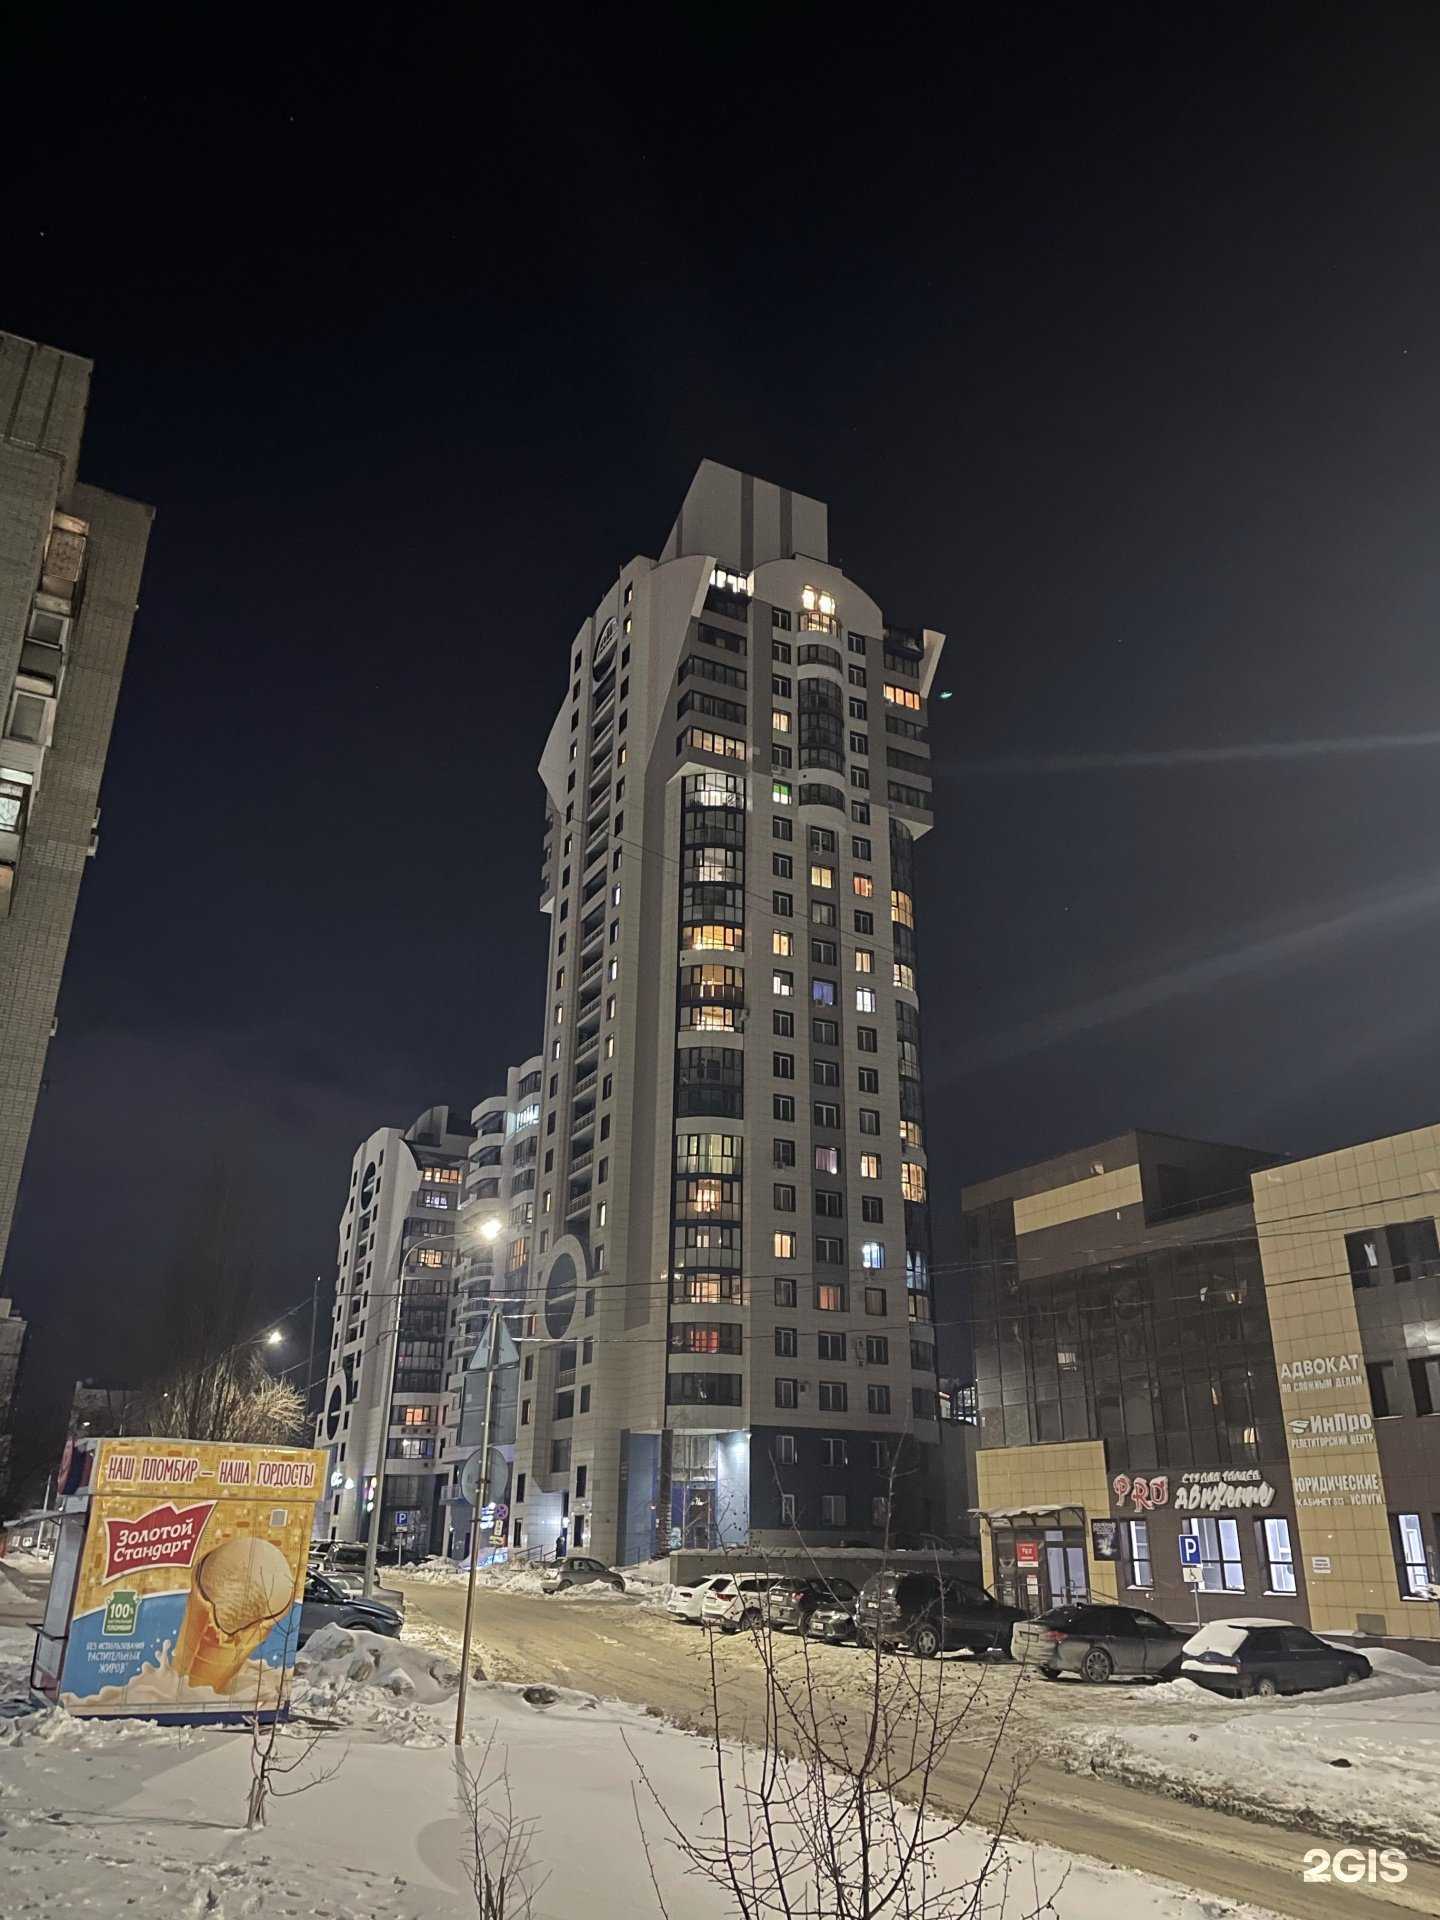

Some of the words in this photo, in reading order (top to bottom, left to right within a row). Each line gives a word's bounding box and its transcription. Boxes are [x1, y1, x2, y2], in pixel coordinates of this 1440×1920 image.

[1281, 1354, 1359, 1379] АДВОКАТ
[1281, 1383, 1292, 1393] ПО
[1336, 1375, 1363, 1388] ДЕЛАМ
[1310, 1413, 1372, 1433] ИнПро
[1351, 1433, 1374, 1445] ЦЕНТР
[107, 1457, 135, 1480] НАШ
[141, 1458, 198, 1481] ПЛОМБИР
[219, 1461, 250, 1484] НАША
[256, 1462, 314, 1487] ГОРДОСТЬ!
[1113, 1473, 1169, 1512] PRO
[1294, 1474, 1379, 1494] ЮРИДИЧЕСКИЕ
[1297, 1497, 1331, 1507] КАБИНЕТ
[1349, 1493, 1383, 1505] УСЛУГИ
[116, 1518, 194, 1546] Золотой
[113, 1539, 191, 1562] Стандарт
[1184, 1538, 1197, 1561] P
